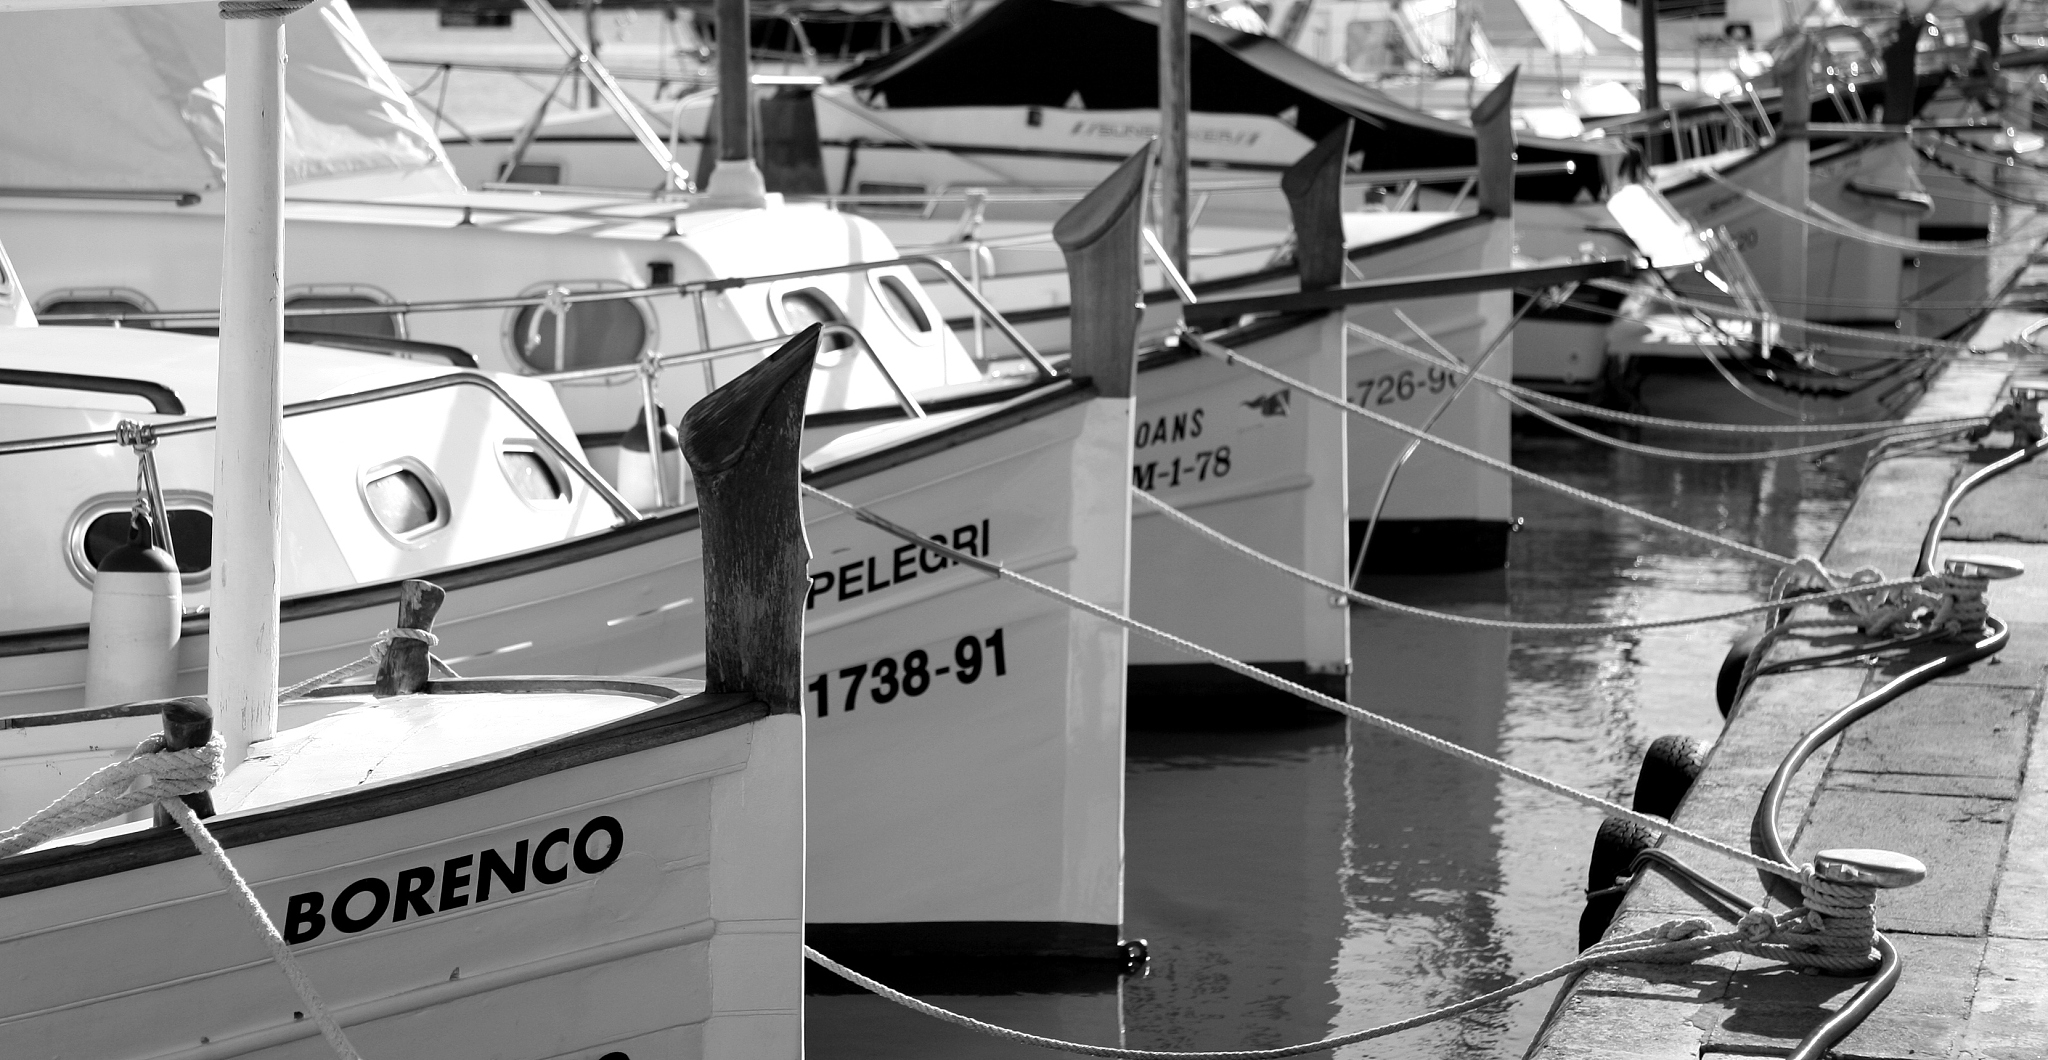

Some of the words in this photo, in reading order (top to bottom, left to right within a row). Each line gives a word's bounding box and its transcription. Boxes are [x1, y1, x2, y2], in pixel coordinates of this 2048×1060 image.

[806, 518, 990, 610] PELEGRI
[808, 628, 1006, 718] 1738-91
[284, 815, 624, 946] BORENCO
